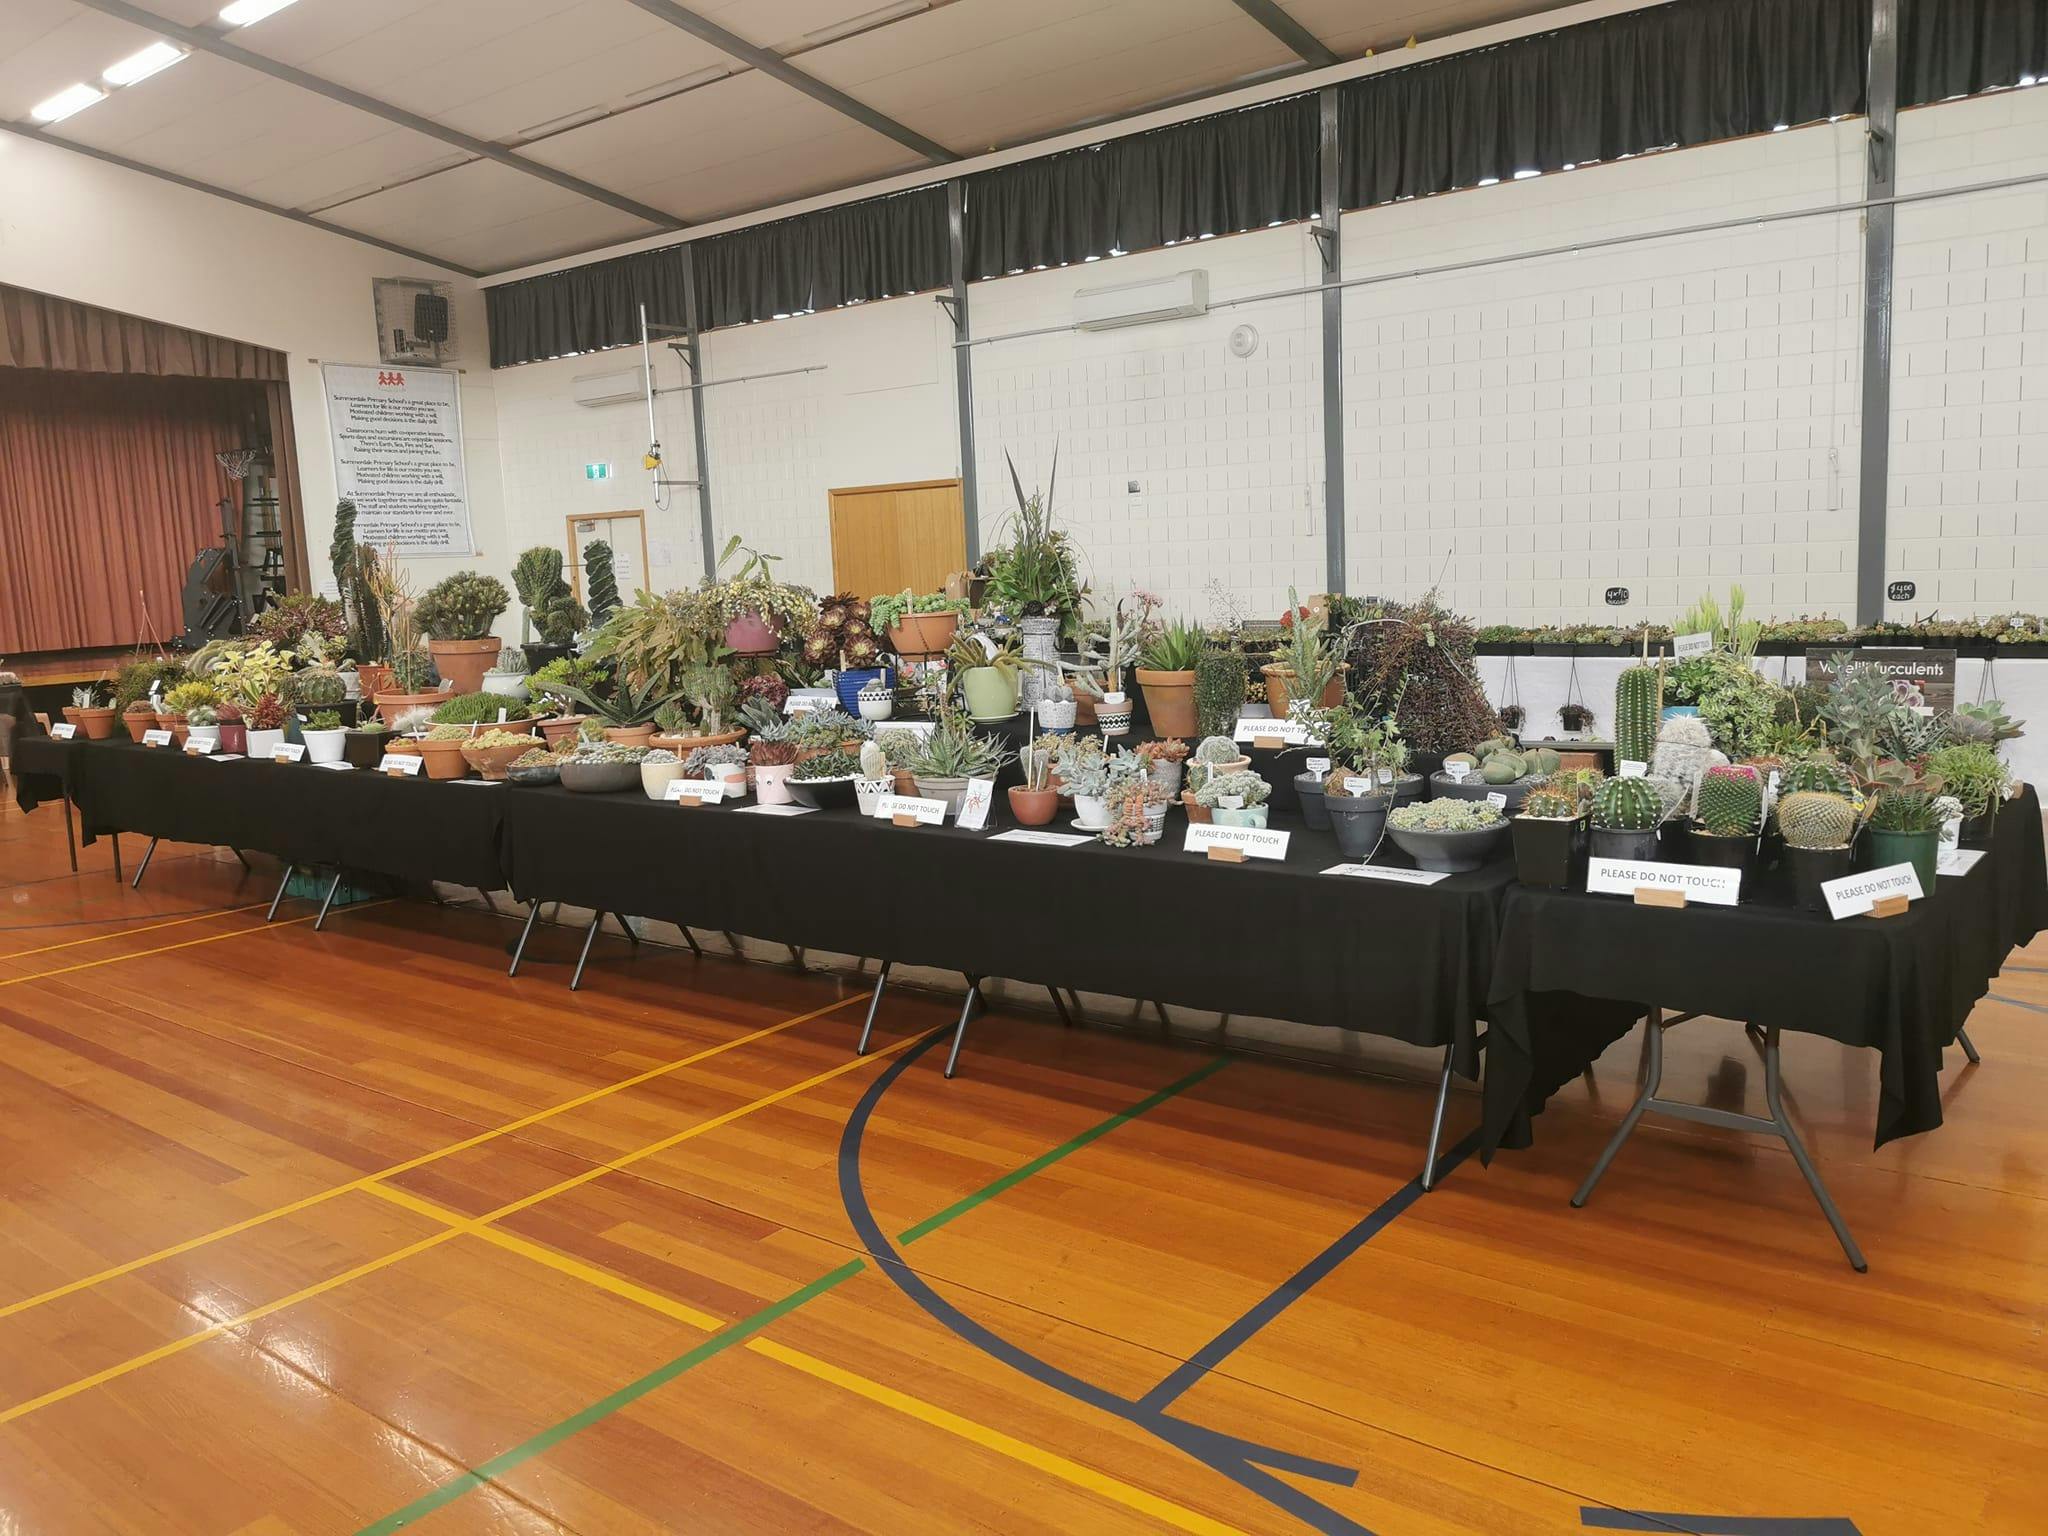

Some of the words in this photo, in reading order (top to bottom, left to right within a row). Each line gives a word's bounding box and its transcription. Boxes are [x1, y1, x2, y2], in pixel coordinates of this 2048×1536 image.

[920, 806, 940, 814] TOUCH
[1195, 830, 1219, 838] PLEASE
[1252, 835, 1279, 845] TOUCH
[1601, 868, 1637, 880] PLEASE
[1640, 872, 1656, 881] DO
[1659, 874, 1683, 884] NOT
[1836, 886, 1864, 900] PLEASE
[1864, 883, 1877, 893] DO
[1877, 879, 1892, 890] NOT
[1892, 874, 1912, 886] TOUCH
